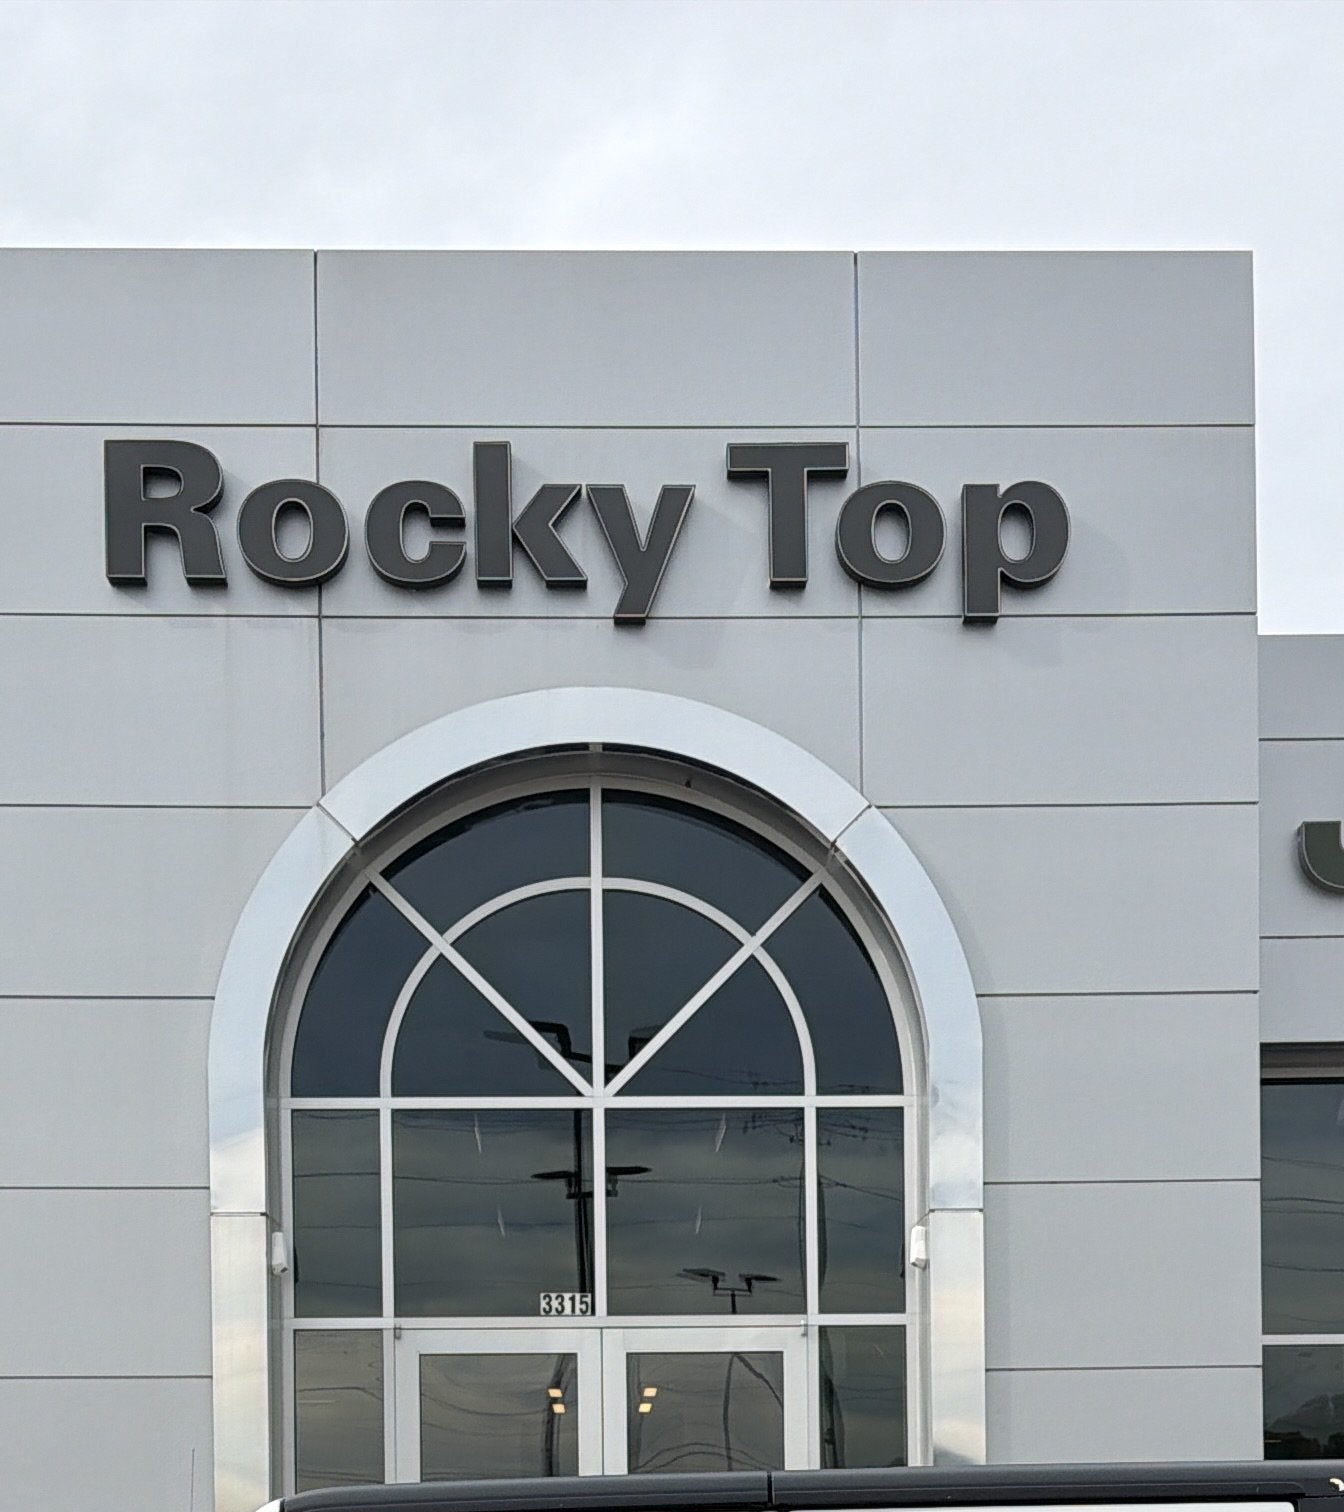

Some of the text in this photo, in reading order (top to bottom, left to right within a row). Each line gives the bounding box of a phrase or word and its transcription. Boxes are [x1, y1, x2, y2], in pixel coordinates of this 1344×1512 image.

[104, 439, 1071, 627] Rocky Top
[542, 1293, 589, 1315] 3315
